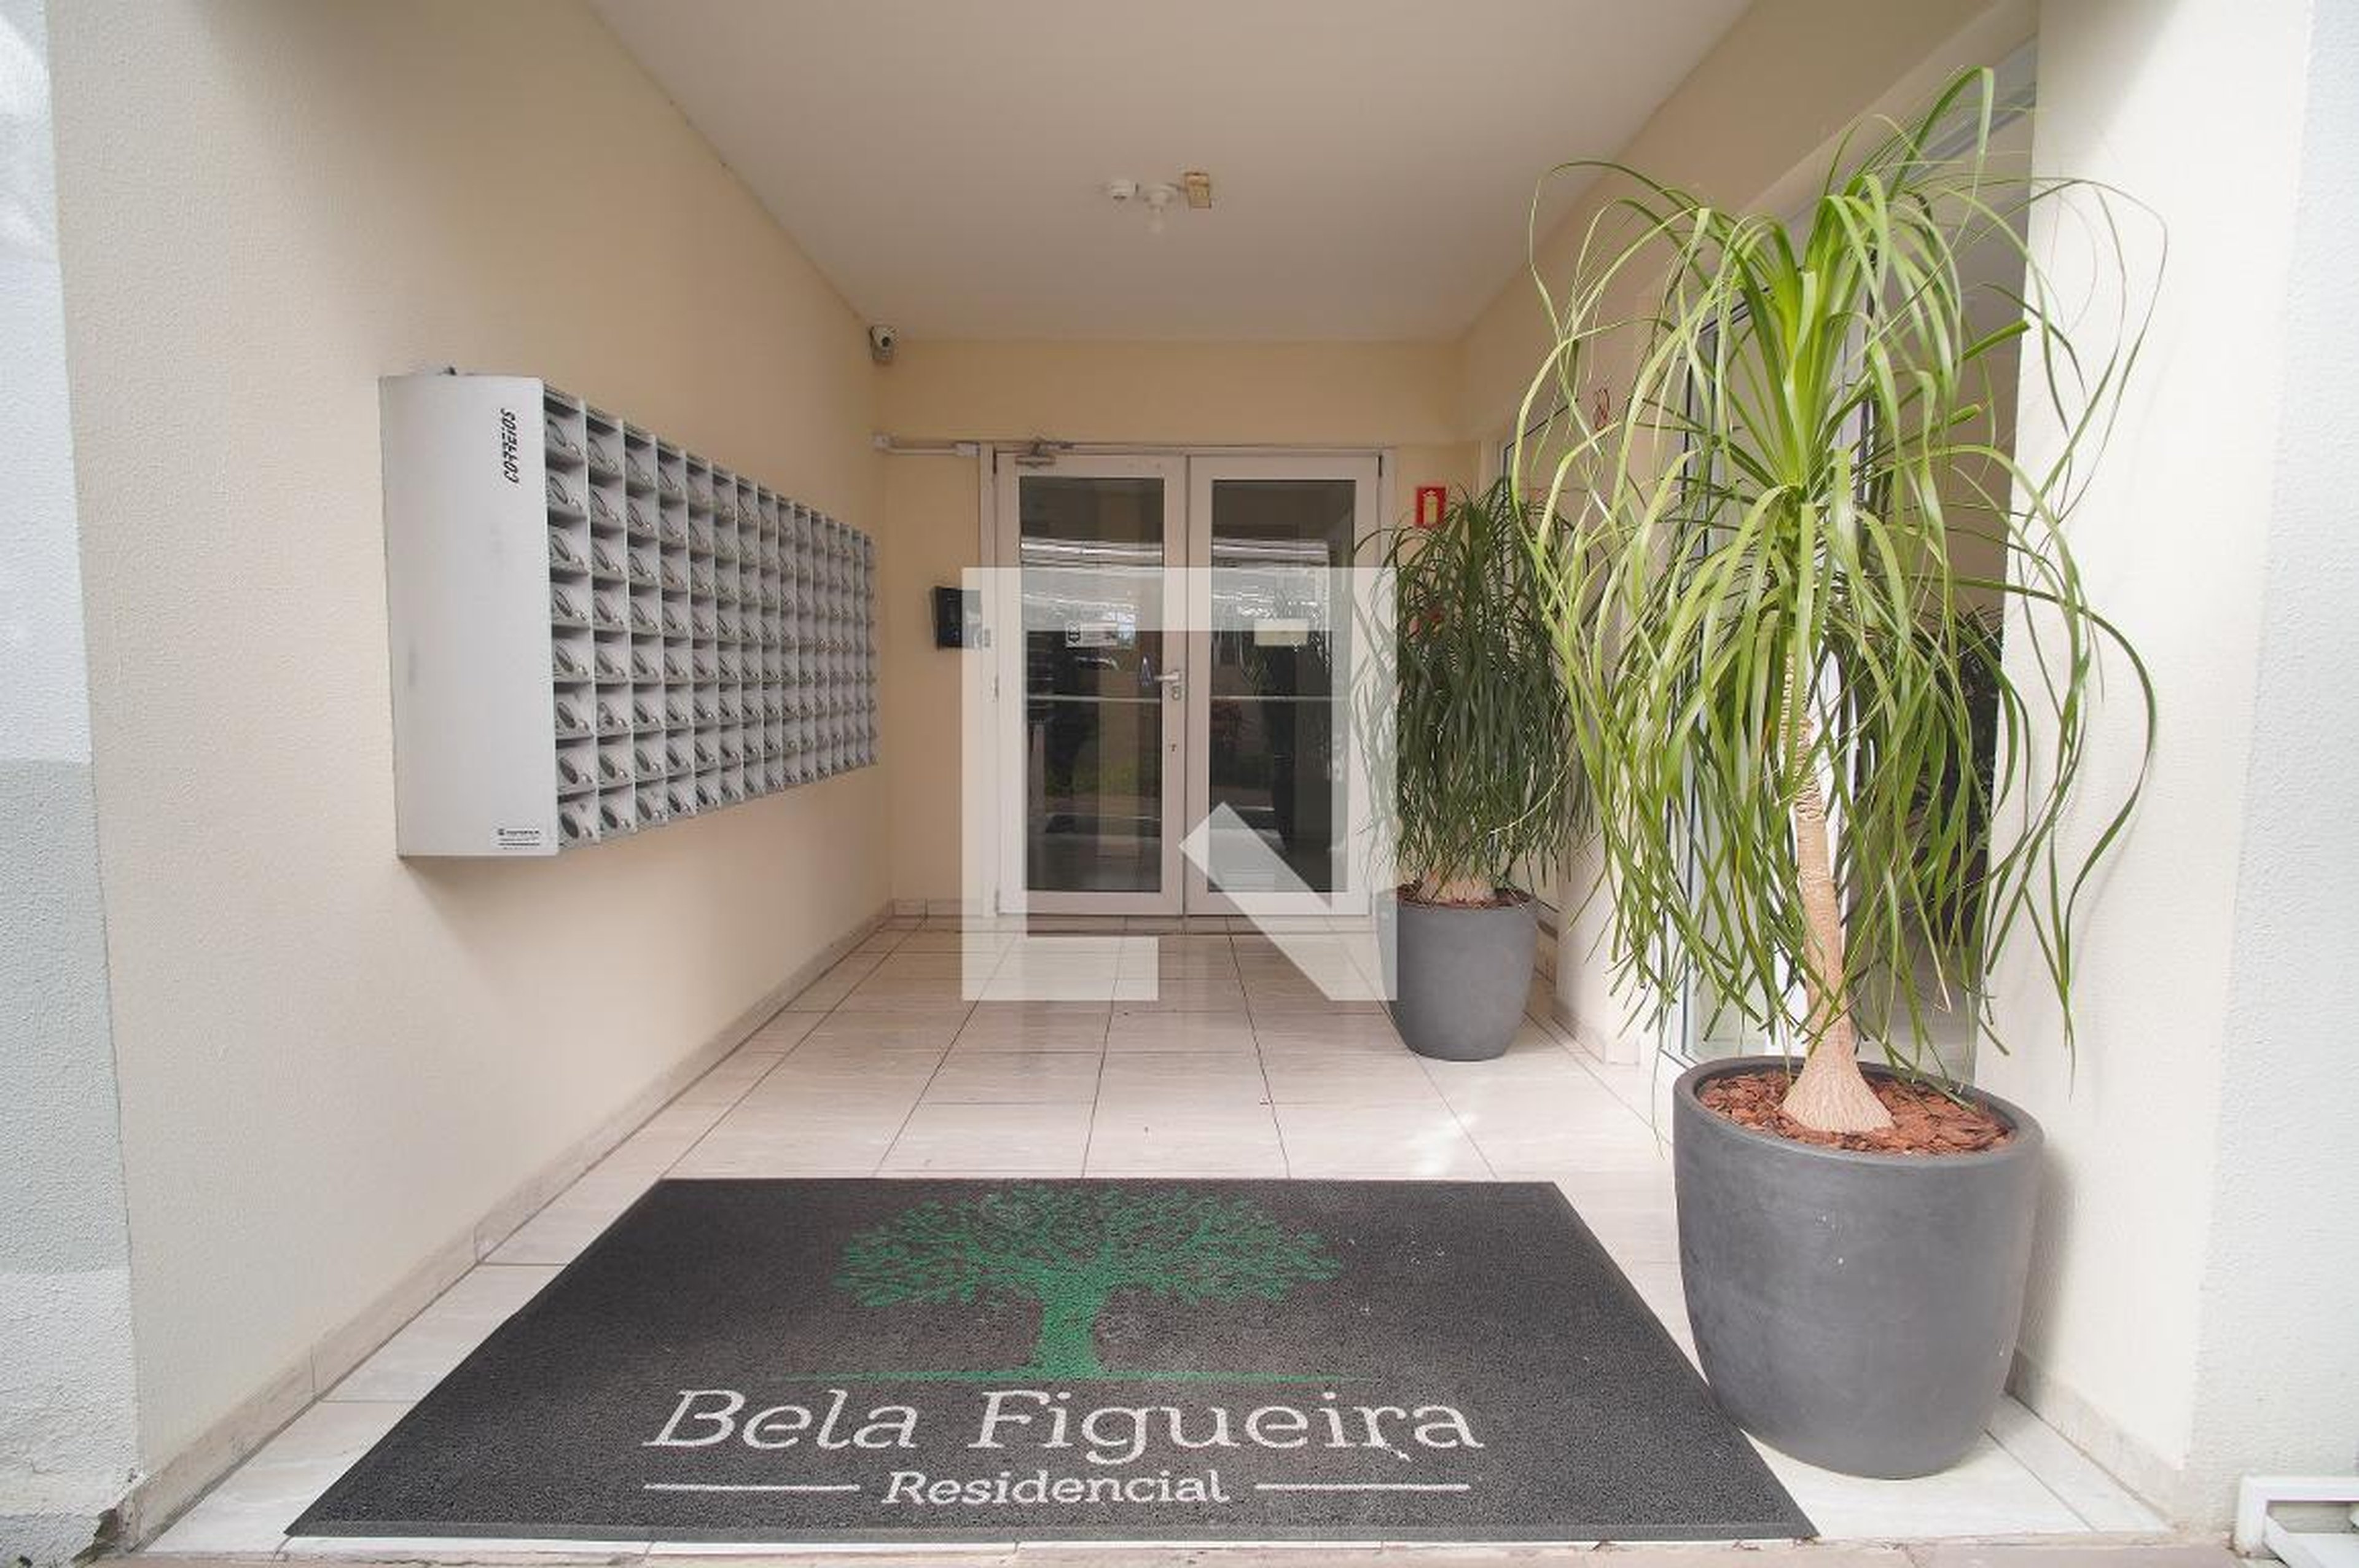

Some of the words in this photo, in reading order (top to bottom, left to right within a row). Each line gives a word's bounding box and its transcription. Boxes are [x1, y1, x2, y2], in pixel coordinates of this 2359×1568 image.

[500, 408, 519, 483] CORREIOS
[641, 1389, 919, 1449] Bela
[968, 1390, 1485, 1464] Figueira
[880, 1469, 1230, 1505] Residencial
